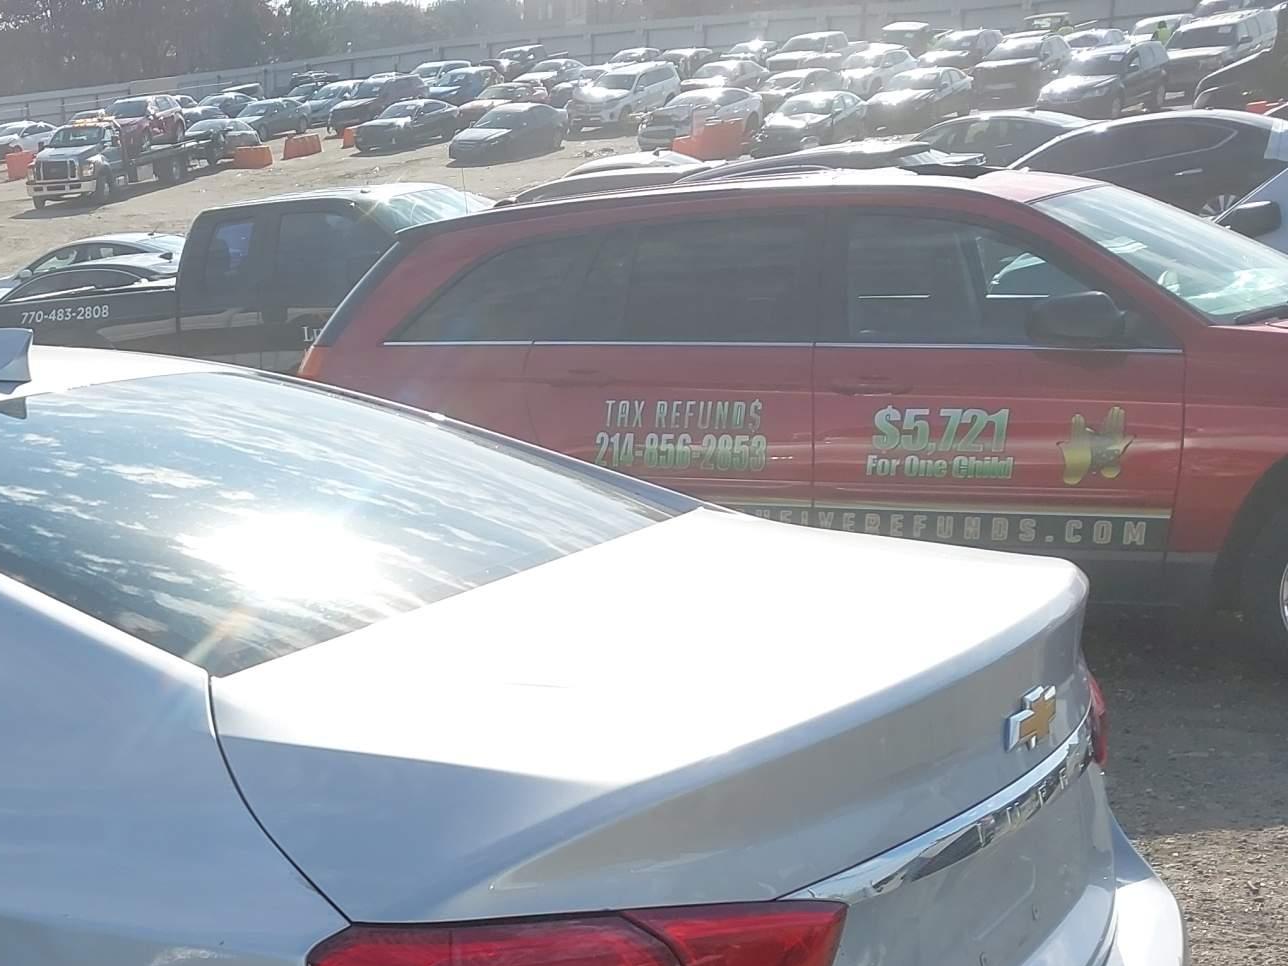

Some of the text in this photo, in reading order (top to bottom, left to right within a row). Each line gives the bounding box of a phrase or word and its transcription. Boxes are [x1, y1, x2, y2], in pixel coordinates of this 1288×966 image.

[20, 304, 110, 325] 770-483-2808
[604, 398, 763, 433] TAX REFUND$
[871, 404, 1011, 456] $5,721
[593, 431, 769, 472] 214-856-2853
[865, 454, 1015, 480] For One Child
